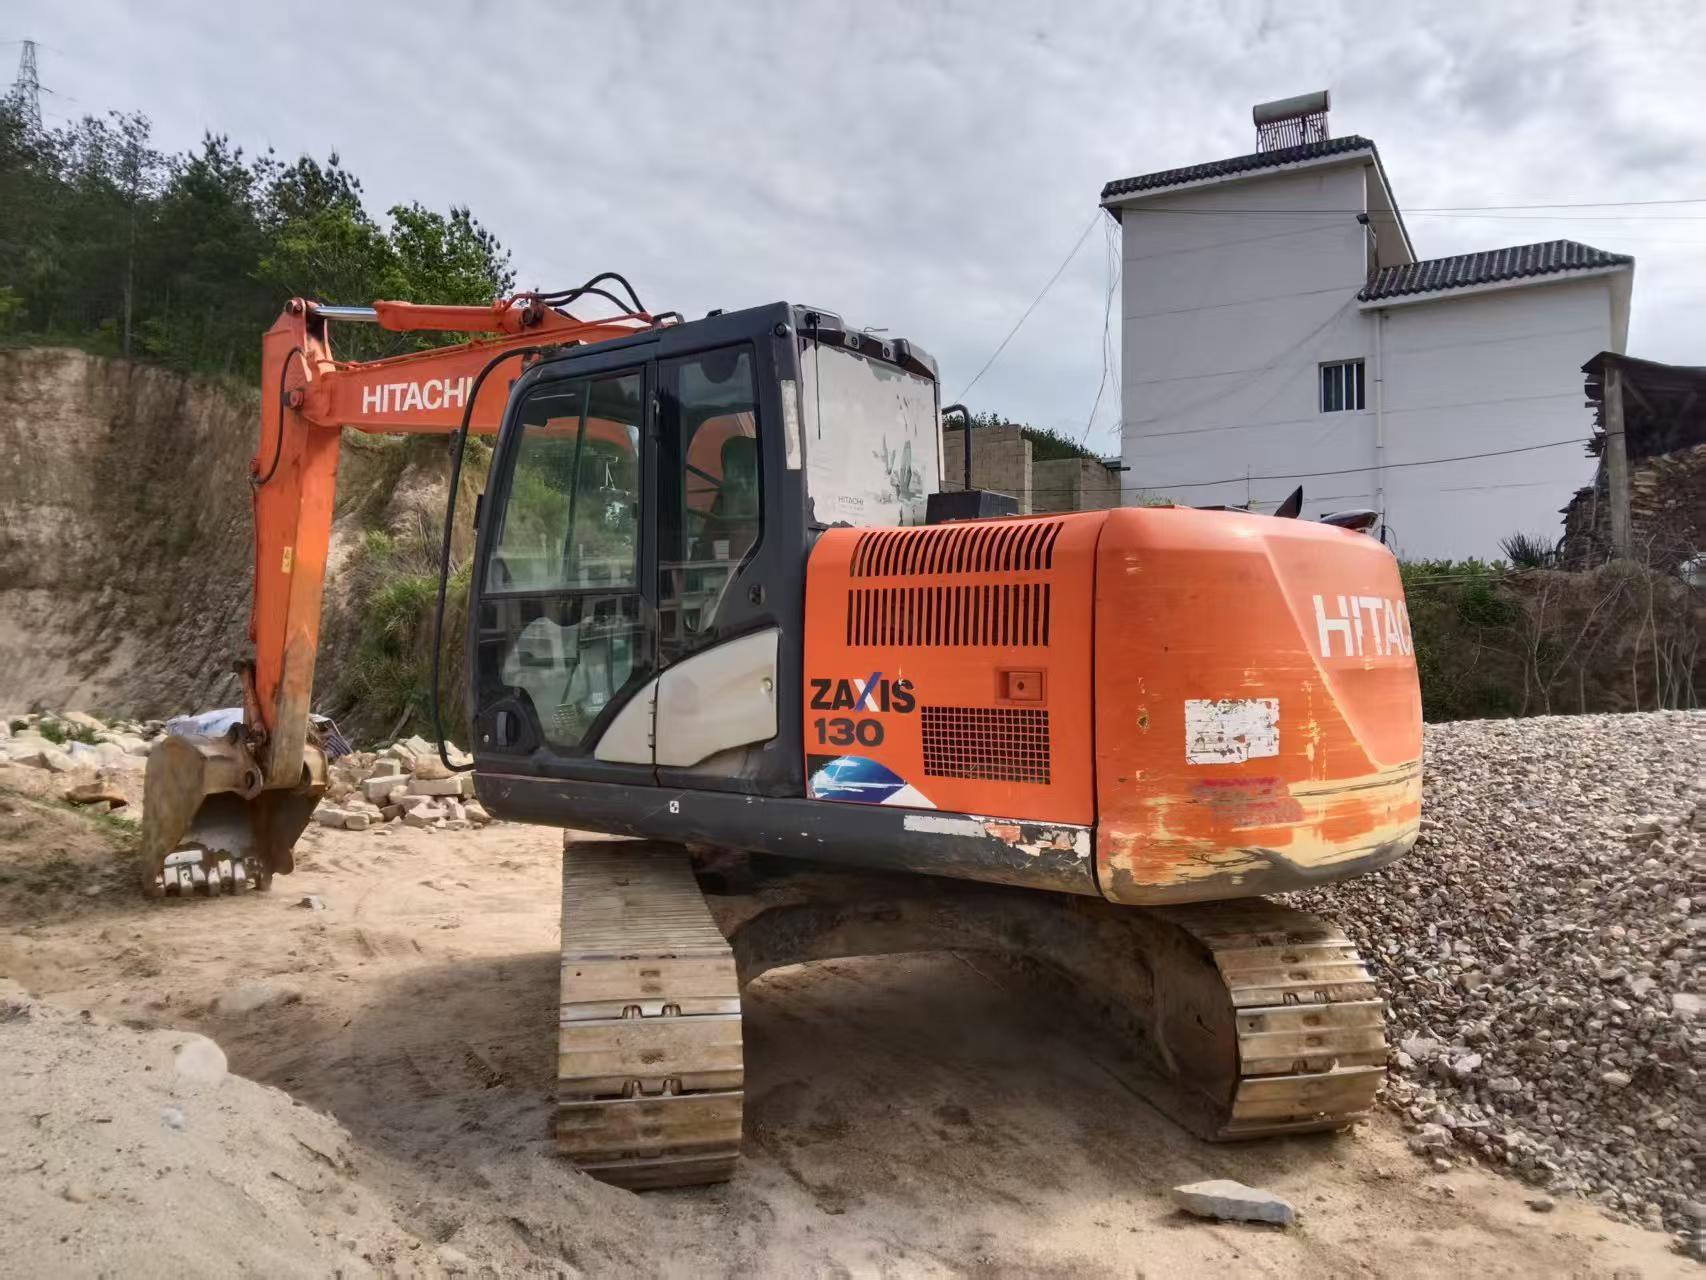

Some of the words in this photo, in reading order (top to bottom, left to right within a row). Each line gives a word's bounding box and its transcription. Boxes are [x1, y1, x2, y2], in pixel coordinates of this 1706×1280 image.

[362, 376, 473, 414] HITACHI
[838, 495, 864, 505] HITACHI
[810, 671, 916, 713] ZAXIS
[814, 717, 884, 747] 130
